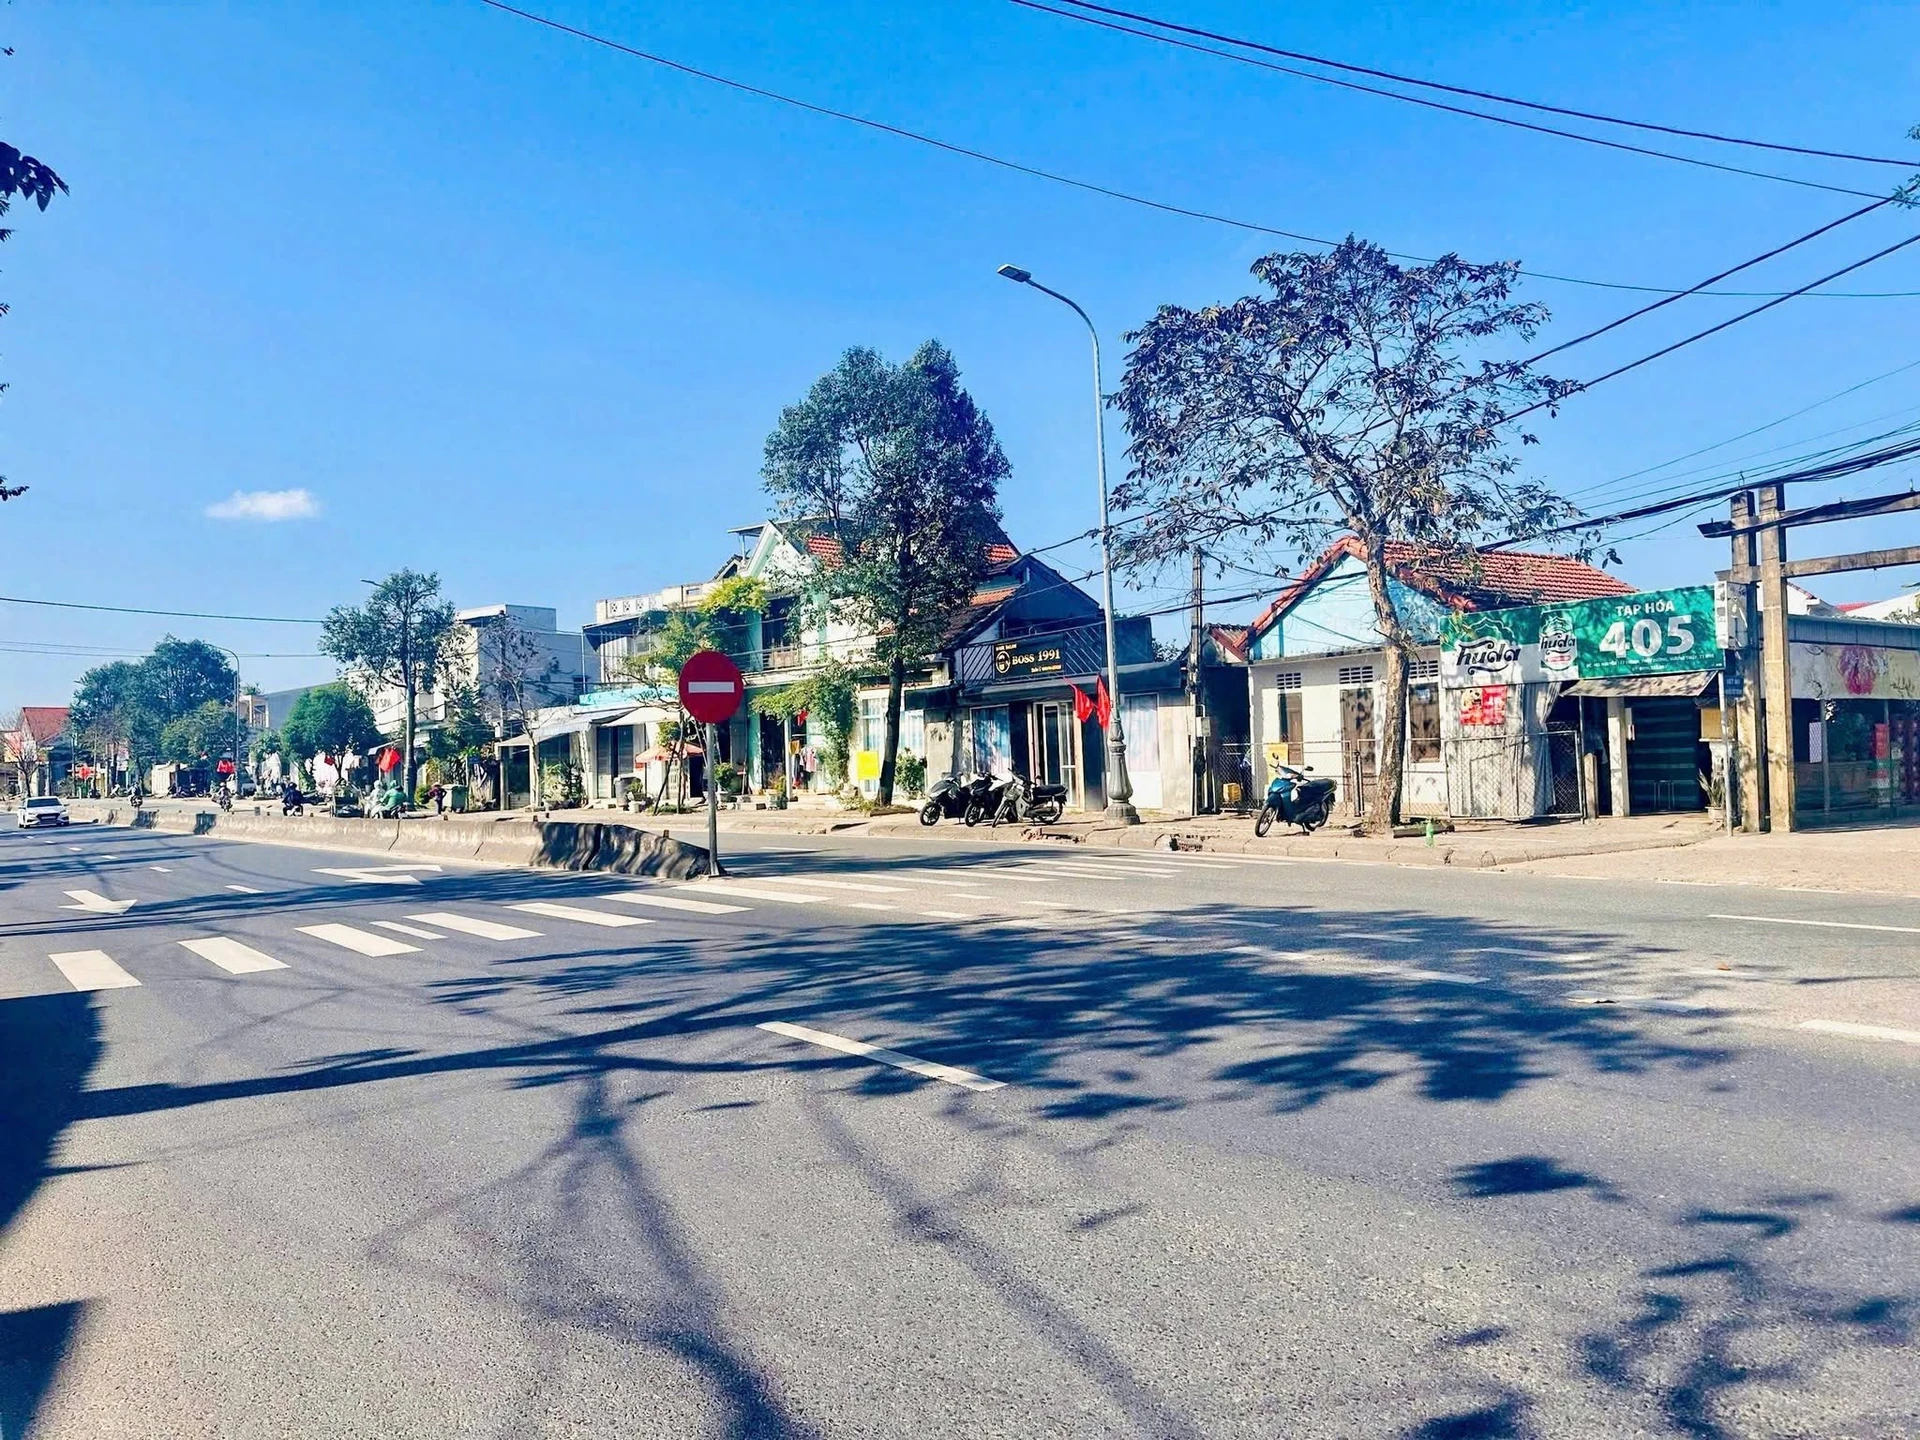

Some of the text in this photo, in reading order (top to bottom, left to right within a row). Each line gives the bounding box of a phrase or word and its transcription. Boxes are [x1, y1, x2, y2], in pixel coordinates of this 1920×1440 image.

[1616, 599, 1675, 618] TẠP HÓA
[1540, 633, 1576, 650] huda
[1599, 614, 1695, 659] 405
[1012, 649, 1060, 665] BOSS 1991
[1457, 640, 1521, 668] huda
